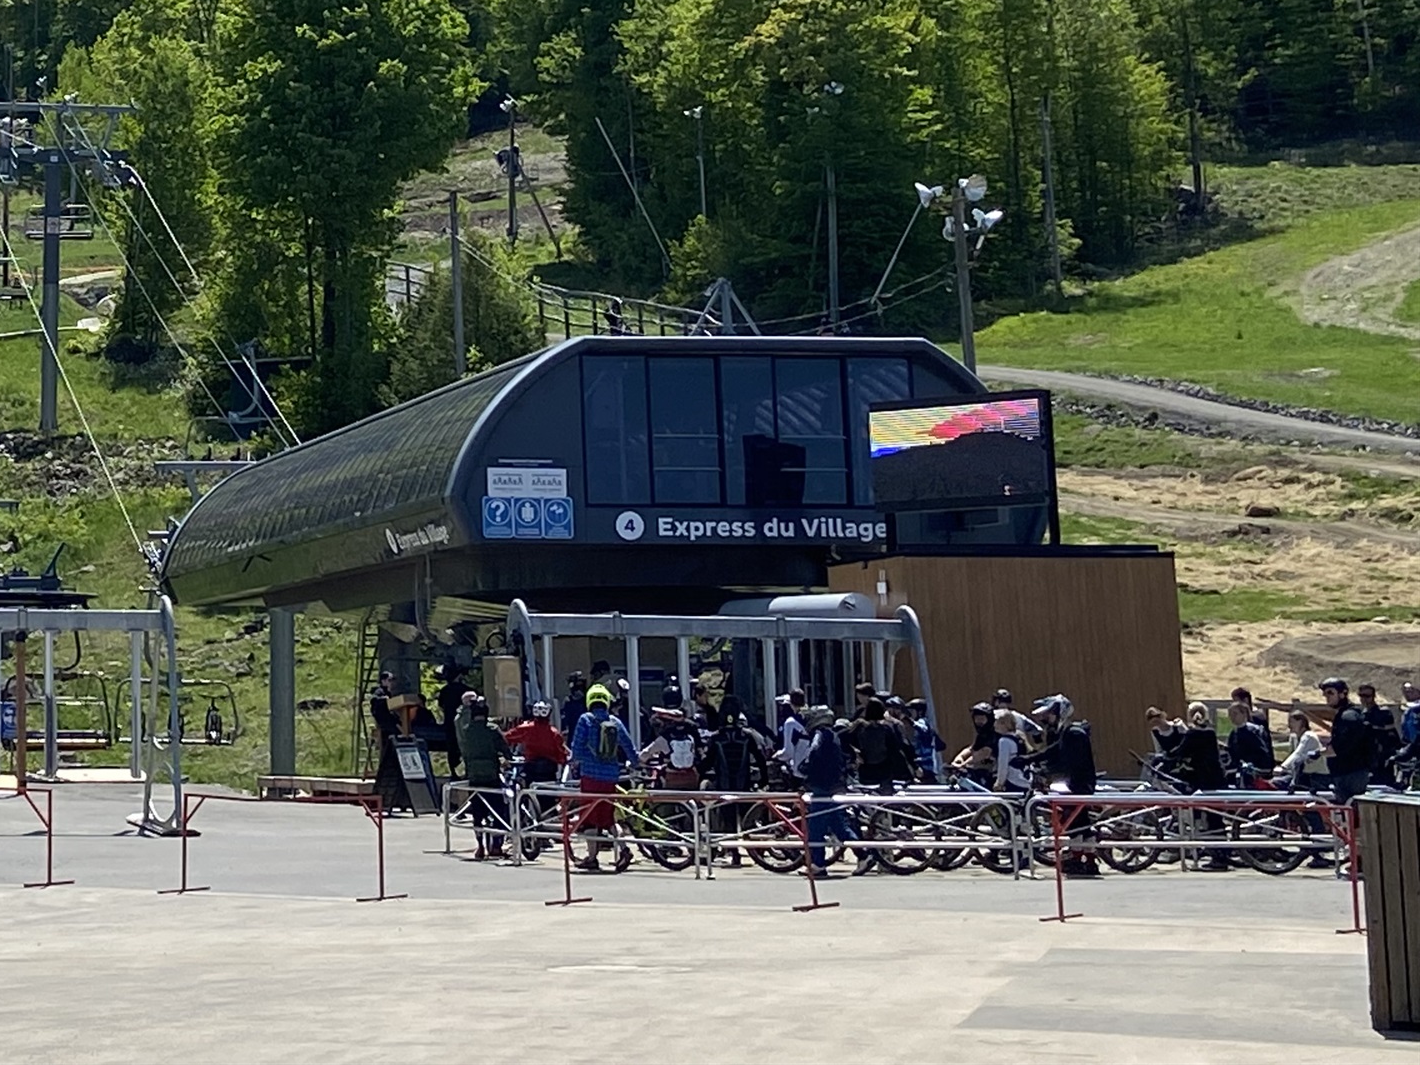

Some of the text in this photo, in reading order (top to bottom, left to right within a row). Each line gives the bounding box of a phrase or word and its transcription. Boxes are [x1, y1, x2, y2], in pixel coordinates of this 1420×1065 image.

[624, 517, 887, 542] 4 Express du Village
